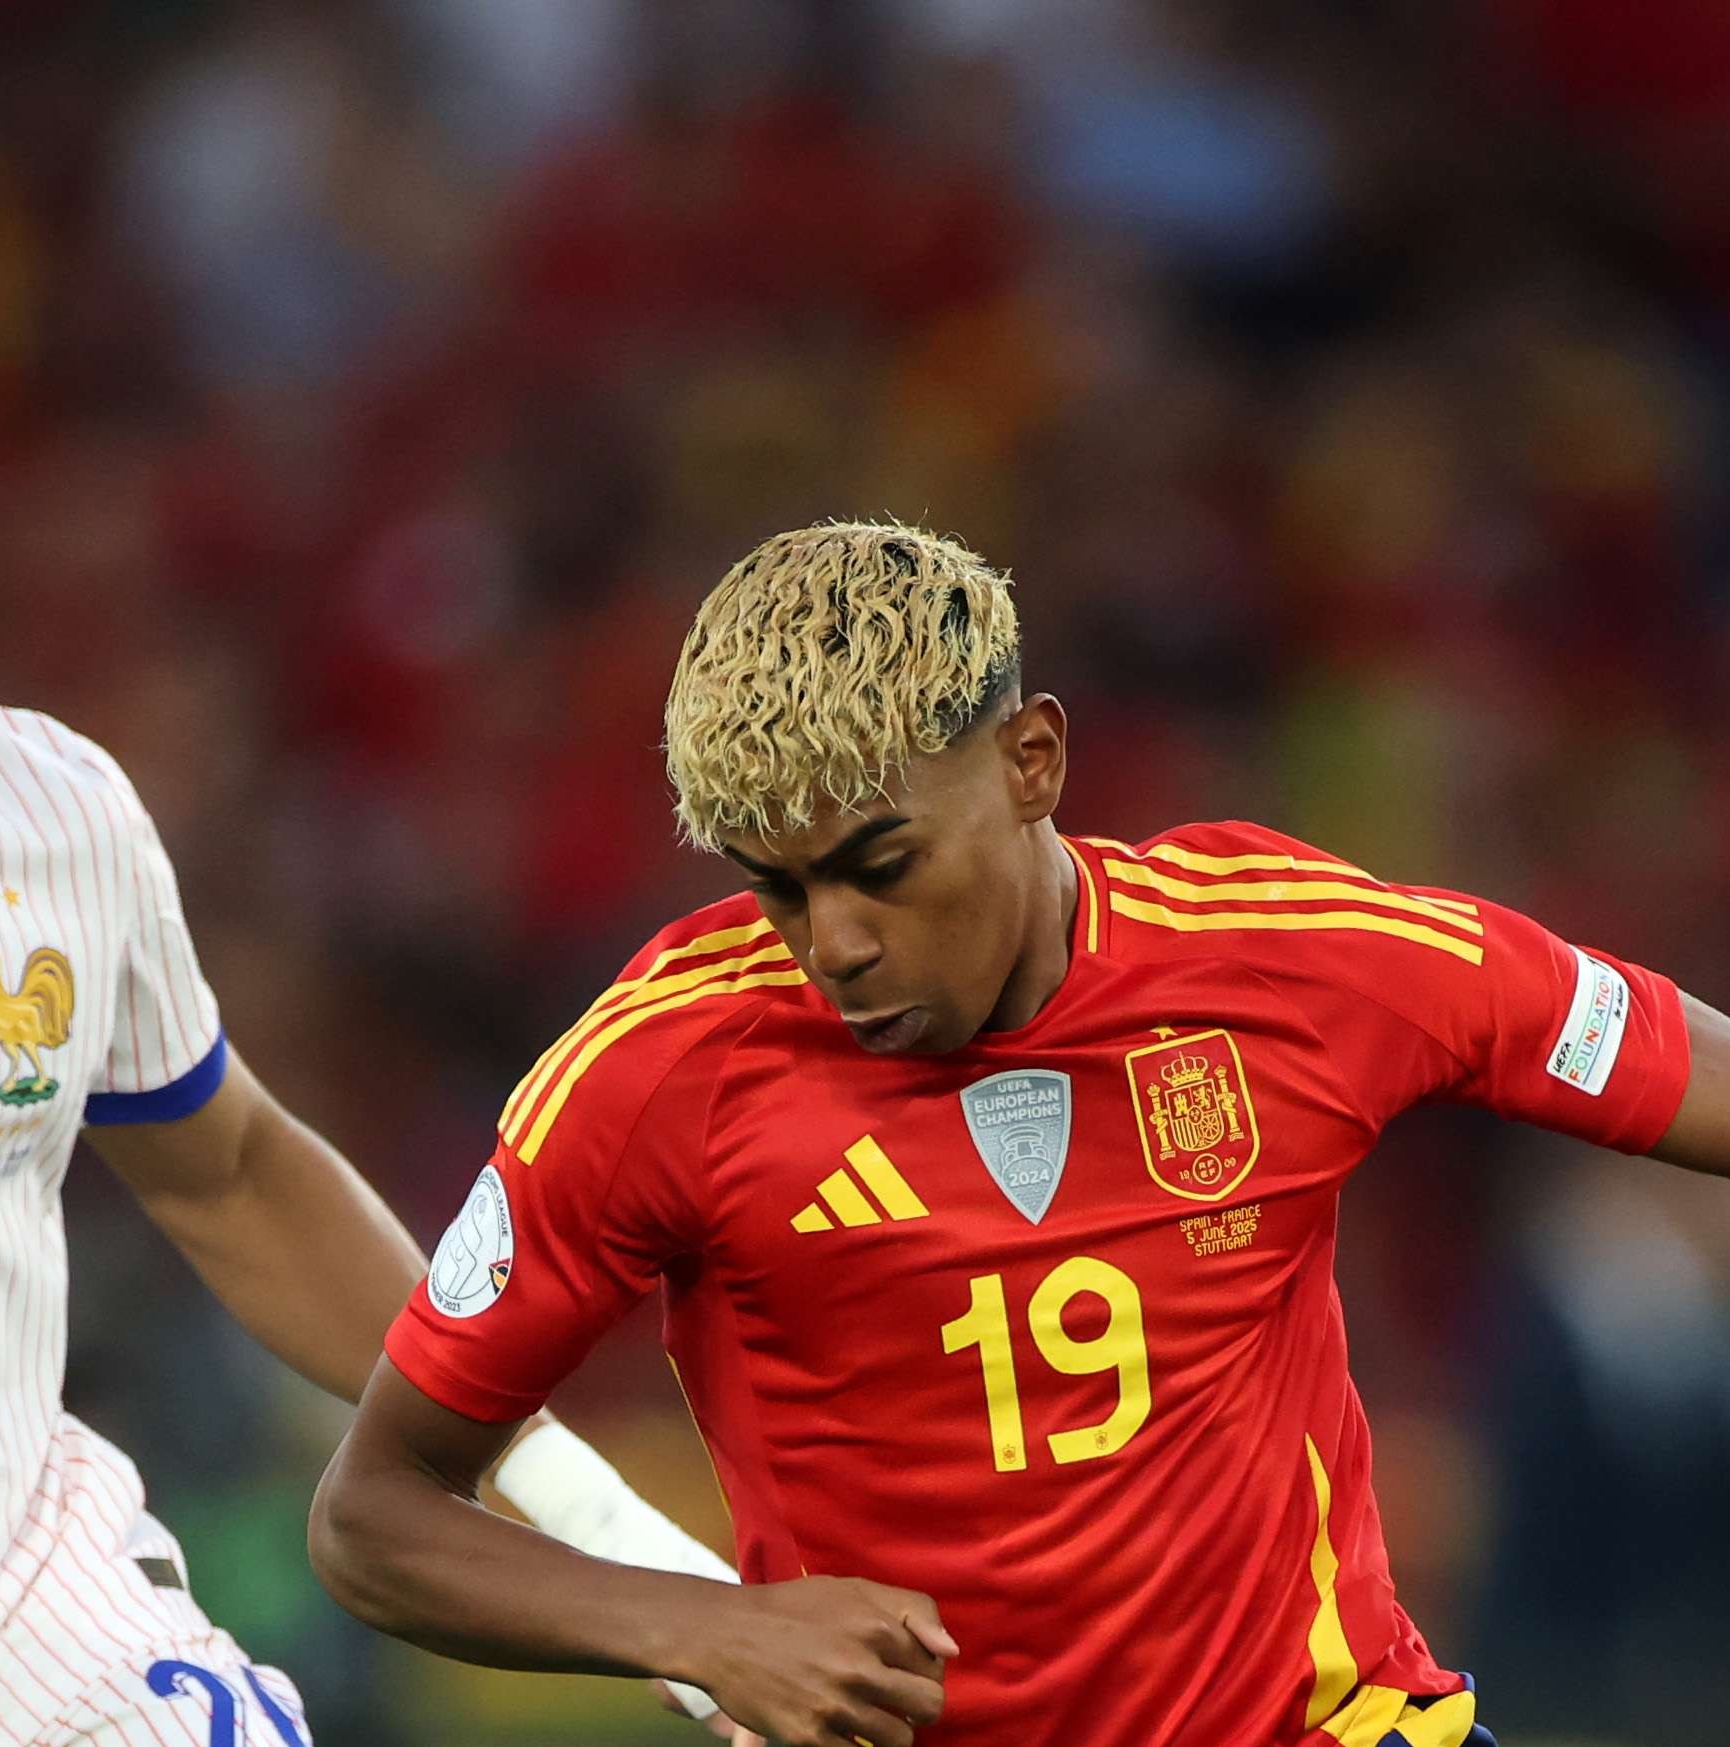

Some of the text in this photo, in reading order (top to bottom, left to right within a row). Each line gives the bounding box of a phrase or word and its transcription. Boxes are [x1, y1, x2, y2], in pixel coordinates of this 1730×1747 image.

[1568, 973, 1612, 1083] FOUNDATION
[1553, 1041, 1573, 1073] UEFA
[997, 1078, 1033, 1093] UEFA
[973, 1089, 1060, 1114] EUROPEAN
[976, 1103, 1063, 1128] CHAMPIONS
[1008, 1169, 1051, 1187] 2024
[495, 1193, 509, 1239] LEAGUE
[1179, 1215, 1212, 1233] SPAIN
[1221, 1203, 1262, 1225] FRANCE
[1186, 1218, 1258, 1245] 5 JUNE 2025
[1194, 1233, 1254, 1257] STUTTGART
[941, 1256, 1152, 1472] 19
